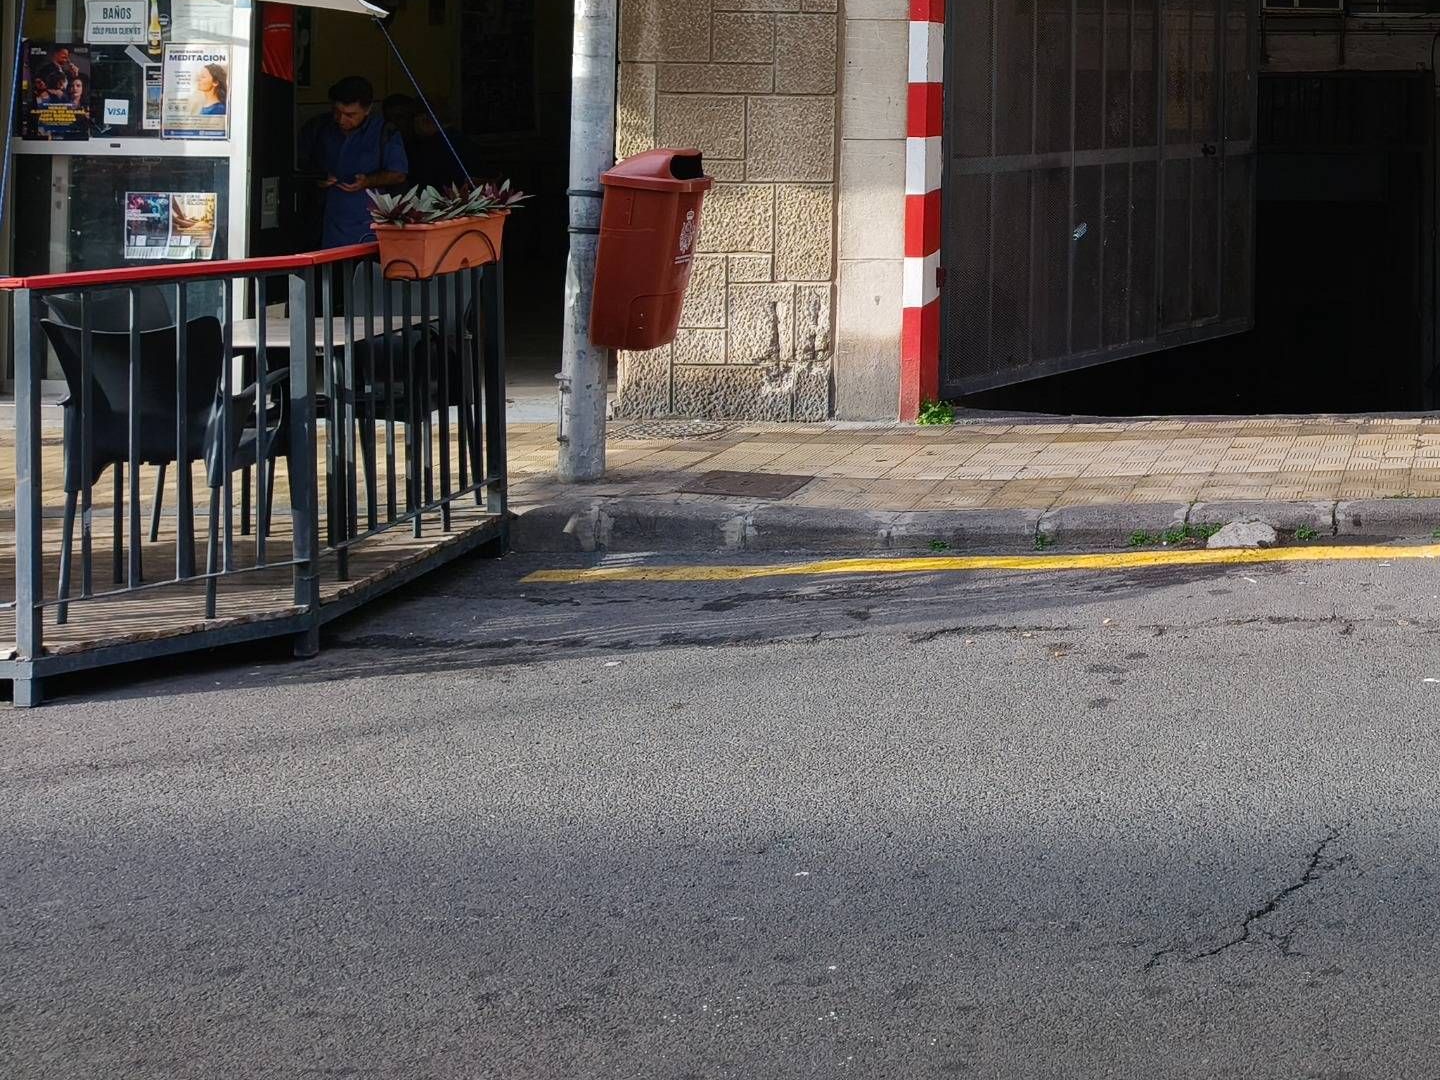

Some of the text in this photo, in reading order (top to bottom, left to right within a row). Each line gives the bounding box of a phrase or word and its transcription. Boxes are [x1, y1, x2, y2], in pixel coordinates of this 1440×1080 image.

[102, 5, 132, 19] BAÑOS
[119, 27, 141, 35] CLIENTES
[107, 108, 127, 116] VISA
